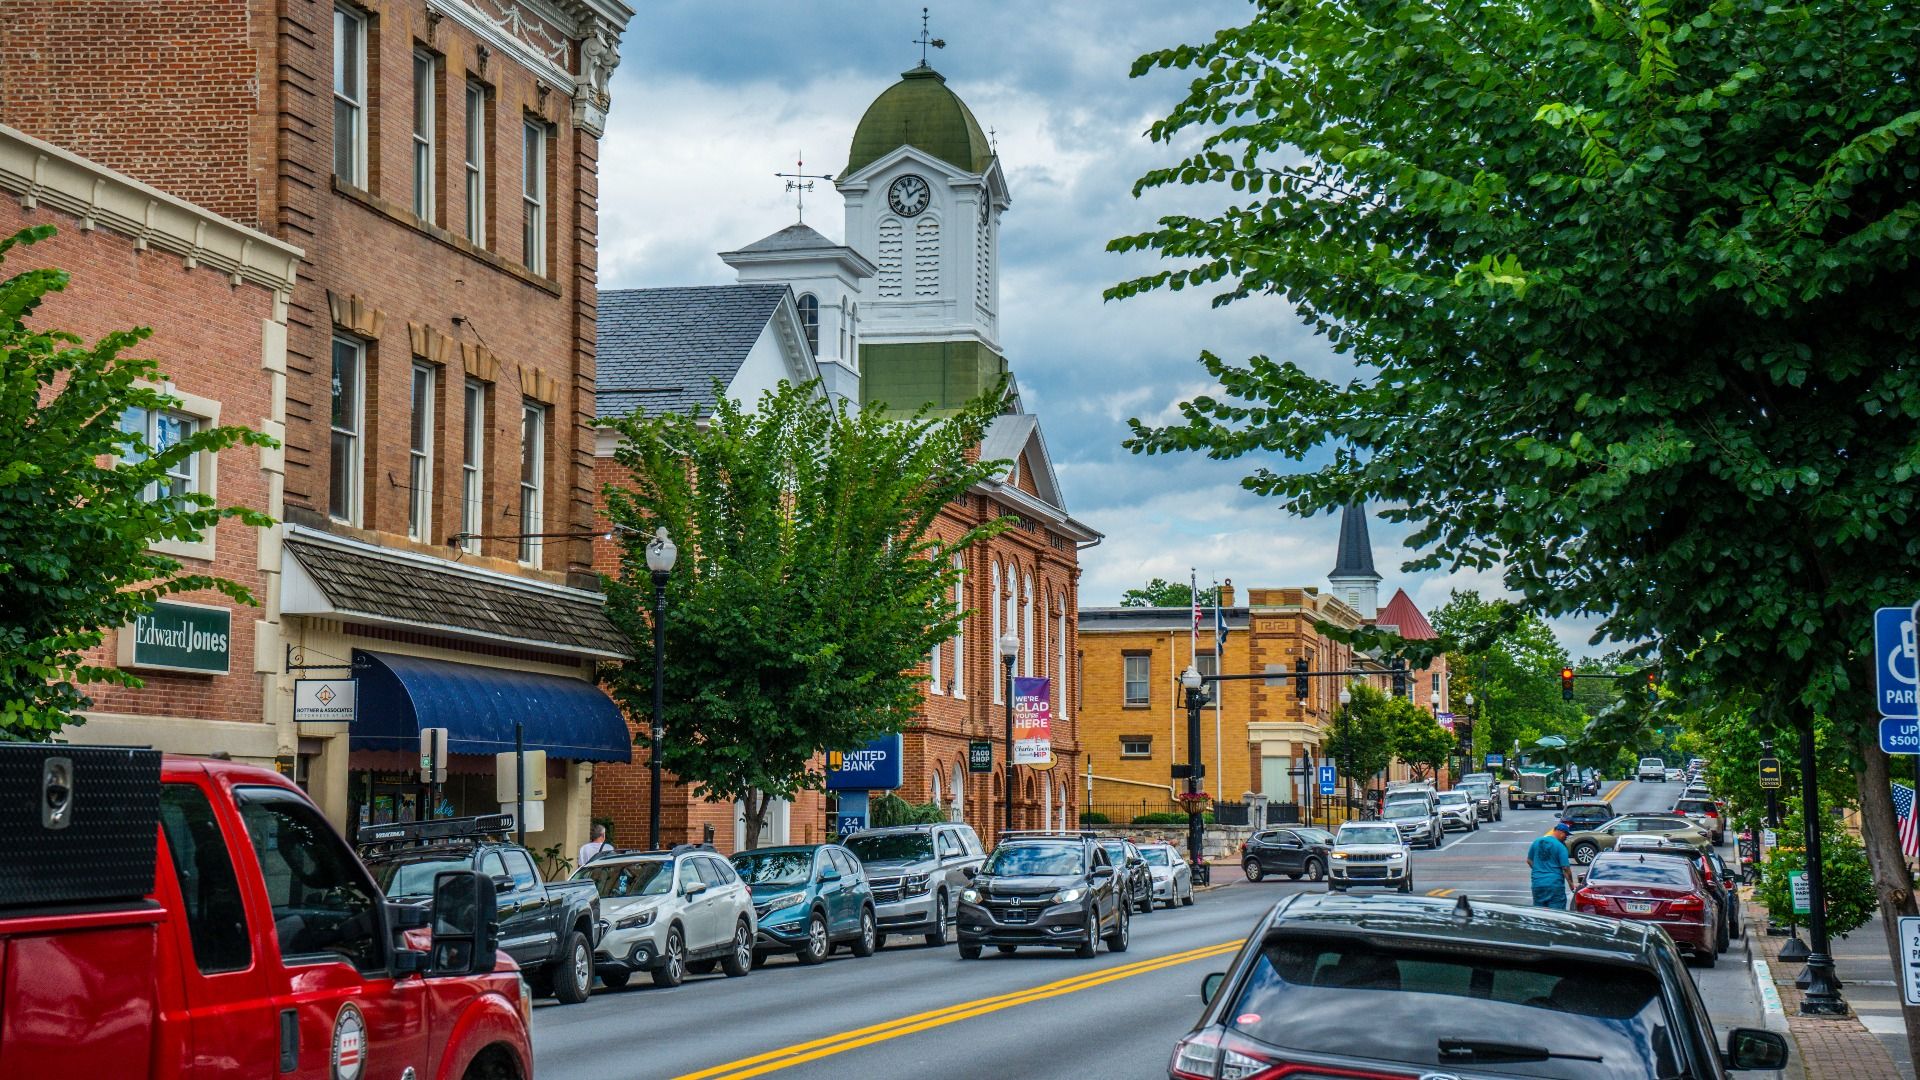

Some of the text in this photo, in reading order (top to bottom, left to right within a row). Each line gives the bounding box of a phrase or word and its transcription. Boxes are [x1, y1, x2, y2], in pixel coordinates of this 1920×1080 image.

[1015, 702, 1049, 712] GLAD
[1016, 719, 1048, 729] HERE
[1900, 725, 1918, 735] UP
[1890, 735, 1918, 746] $500
[843, 751, 886, 761] UNITED
[843, 761, 875, 771] BANK
[1322, 769, 1332, 781] H
[844, 817, 859, 826] 24
